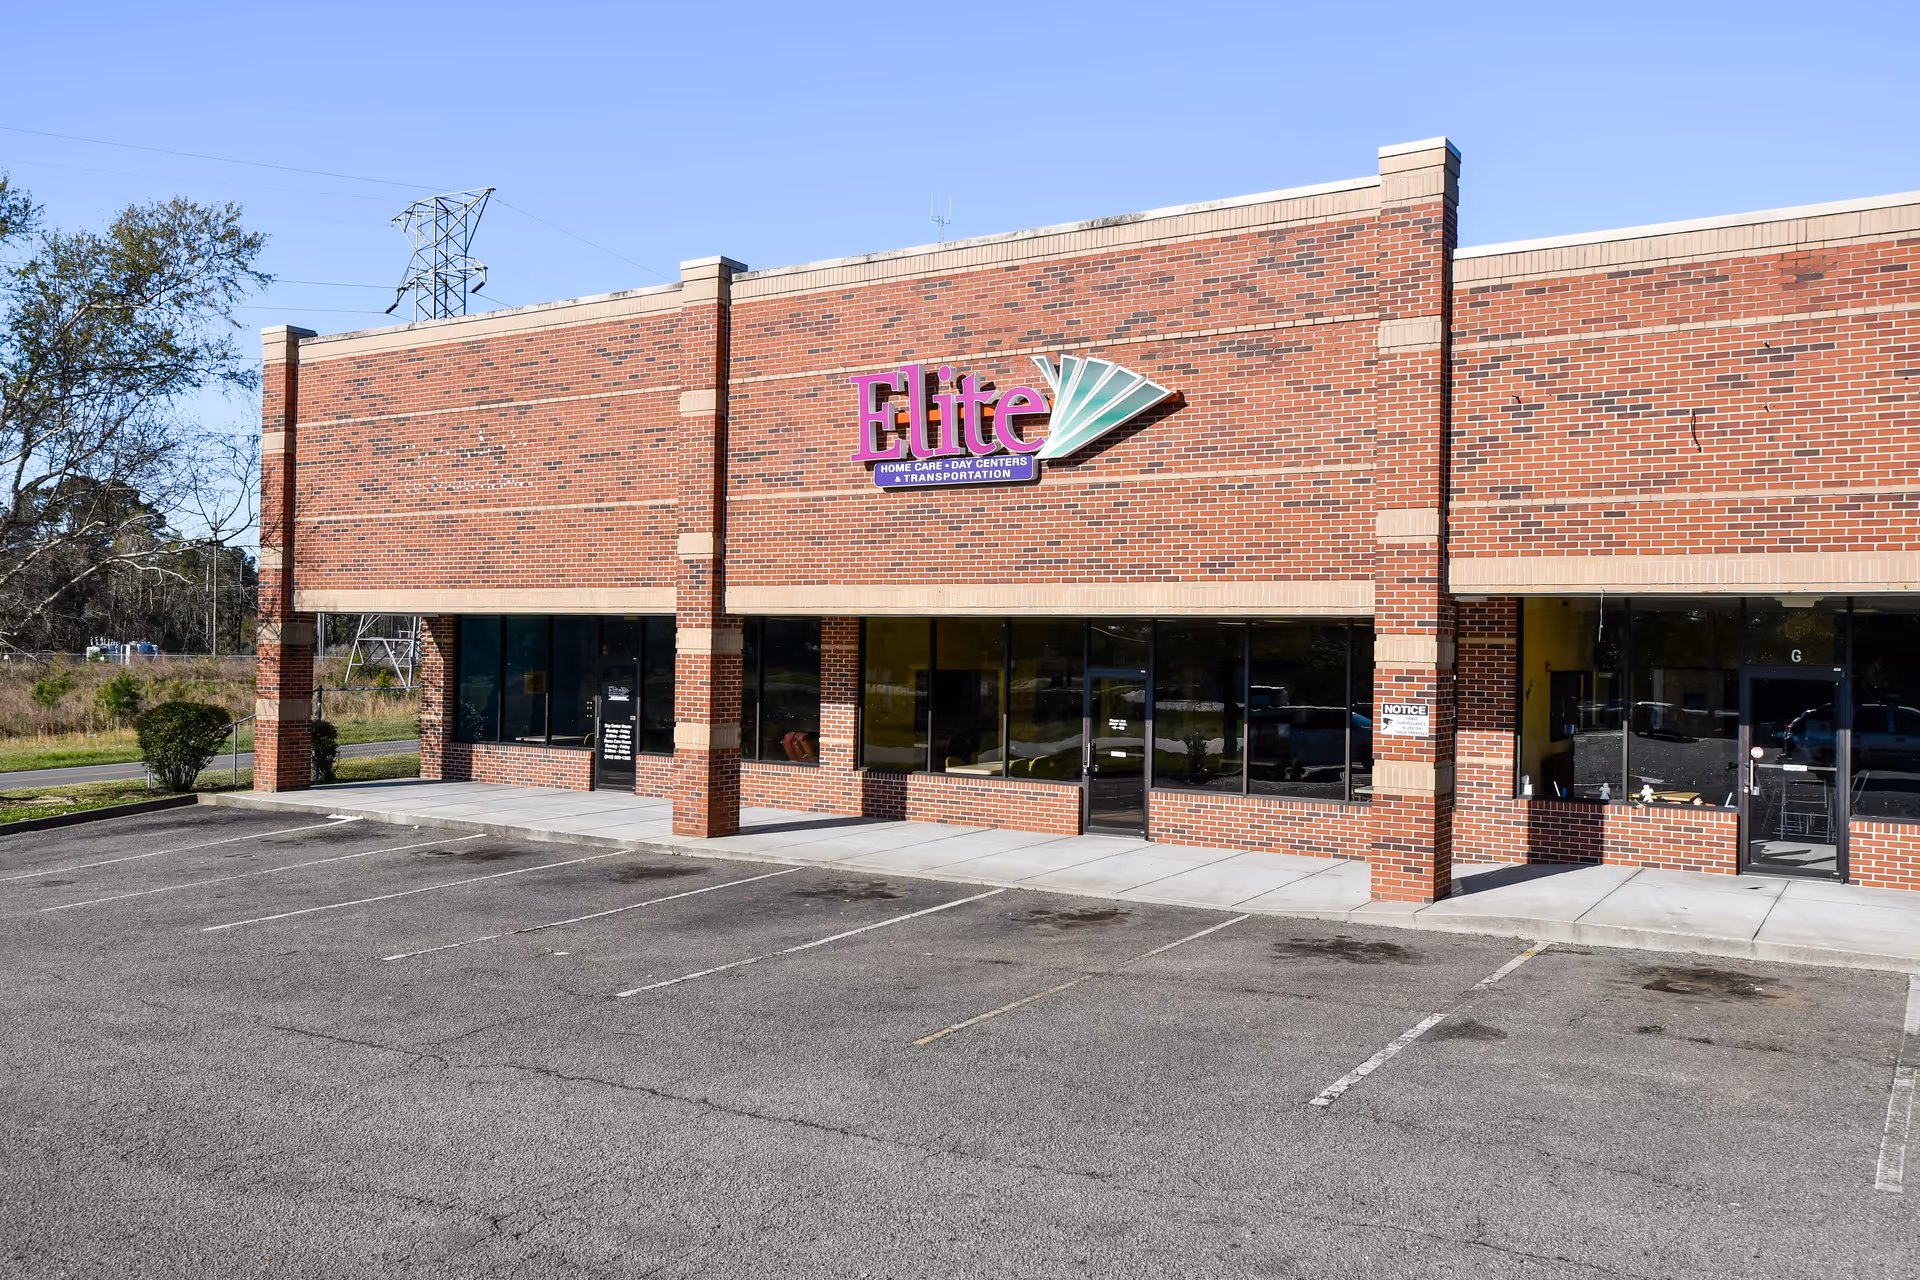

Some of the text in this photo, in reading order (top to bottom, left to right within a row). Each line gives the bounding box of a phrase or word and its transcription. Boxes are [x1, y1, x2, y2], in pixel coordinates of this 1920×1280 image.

[850, 363, 1051, 462] Elite
[880, 456, 1028, 473] HOME CARE DAY CENTERS
[903, 469, 1011, 483] TRANSPORTATION
[1791, 649, 1802, 663] G
[1385, 705, 1426, 714] NOTICE
